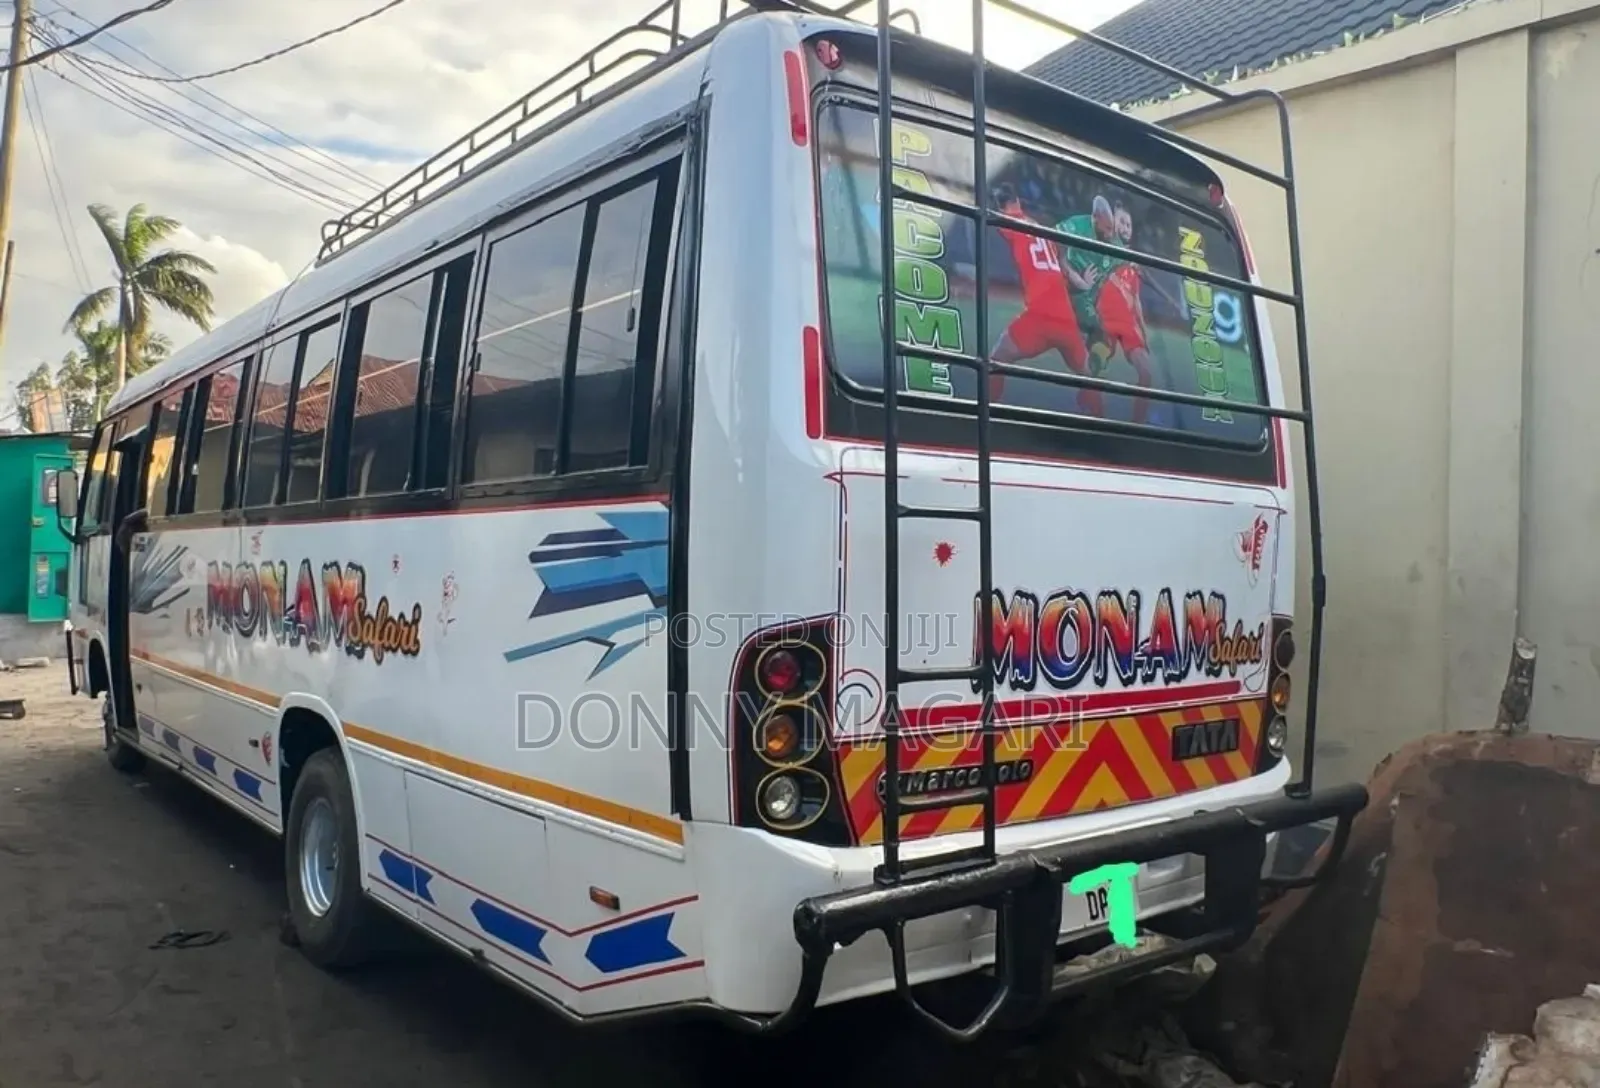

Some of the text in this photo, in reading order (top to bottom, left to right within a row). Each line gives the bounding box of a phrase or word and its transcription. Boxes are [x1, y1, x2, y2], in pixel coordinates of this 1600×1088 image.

[873, 118, 963, 399] PACOME
[206, 557, 422, 665] MONAM Safari
[970, 587, 1266, 693] MONAM Safari
[1174, 719, 1238, 759] TATA
[905, 760, 1031, 794] Marcoolo
[1085, 886, 1108, 920] DP
